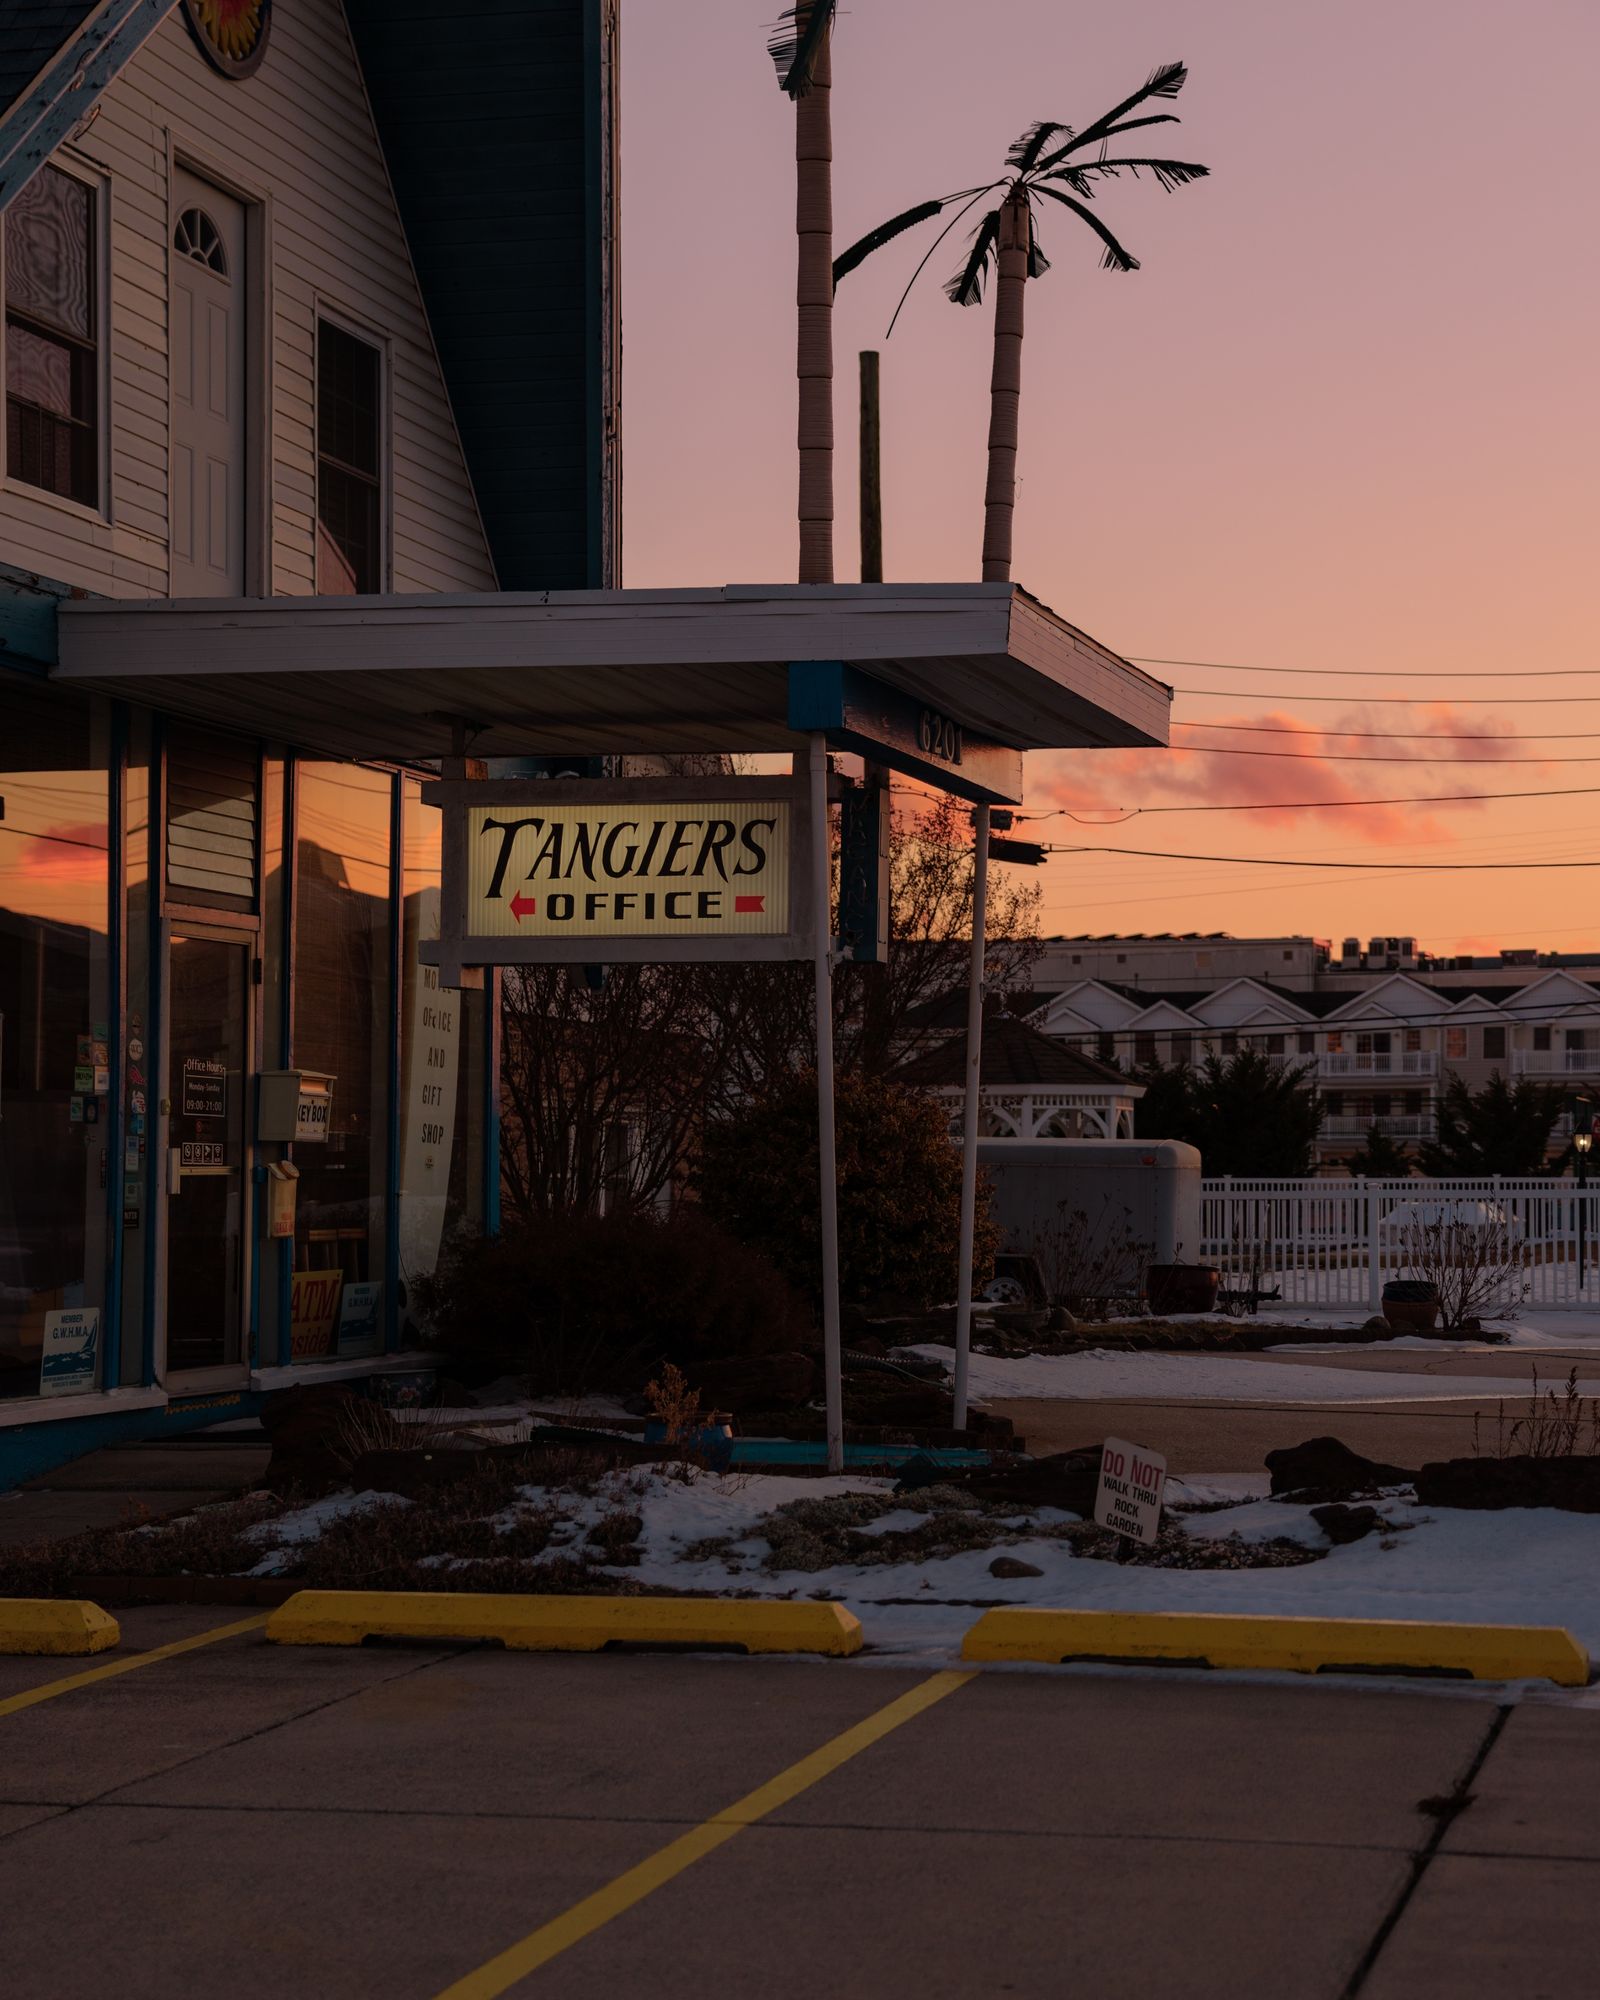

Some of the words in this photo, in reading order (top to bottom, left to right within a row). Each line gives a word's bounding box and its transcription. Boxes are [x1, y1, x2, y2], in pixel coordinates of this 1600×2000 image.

[919, 709, 962, 765] 6201
[481, 815, 777, 899] TANGIERS
[545, 890, 723, 921] OFFICE
[187, 1058, 205, 1072] Office
[206, 1060, 223, 1073] Hours
[427, 1047, 445, 1069] AND
[422, 1084, 442, 1107] GIFT
[311, 1104, 328, 1123] BOX
[422, 1123, 444, 1145] SHOP
[291, 1280, 340, 1323] ATM
[61, 1314, 83, 1324] MEMBER
[1103, 1449, 1125, 1477] DO
[1130, 1456, 1163, 1491] NOT
[1103, 1476, 1128, 1496] WALK
[1132, 1486, 1157, 1506] THRU
[1114, 1498, 1139, 1518] ROCK
[1106, 1513, 1144, 1537] GARDEN
